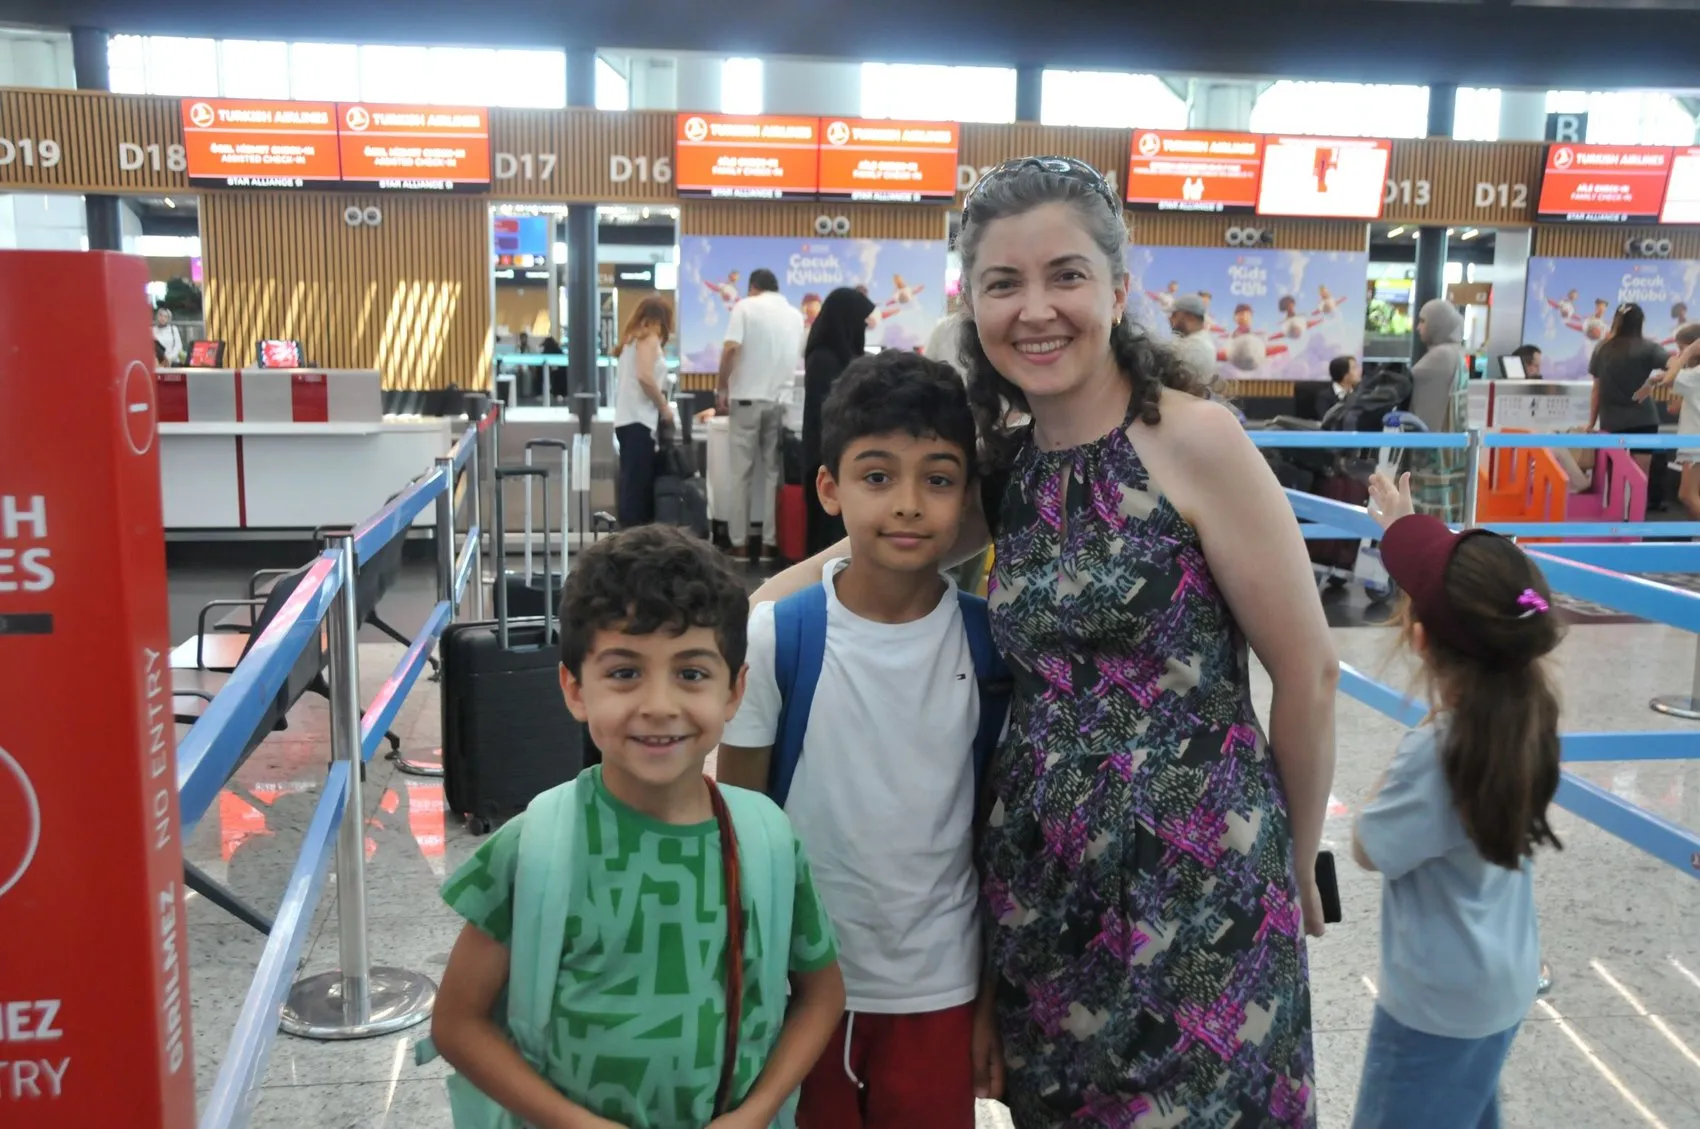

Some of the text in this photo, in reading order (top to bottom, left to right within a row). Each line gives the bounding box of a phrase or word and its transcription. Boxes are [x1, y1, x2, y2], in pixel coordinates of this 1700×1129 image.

[218, 109, 329, 124] TURKISH AIRLINES
[372, 113, 425, 126] TURKISH
[0, 138, 60, 168] D19
[119, 143, 187, 171] D18
[495, 153, 557, 181] D17
[1576, 153, 1619, 165] TURKISH
[610, 155, 672, 183] D16
[1475, 182, 1528, 208] D12
[145, 647, 167, 778] ENTRY
[155, 788, 172, 850] NO
